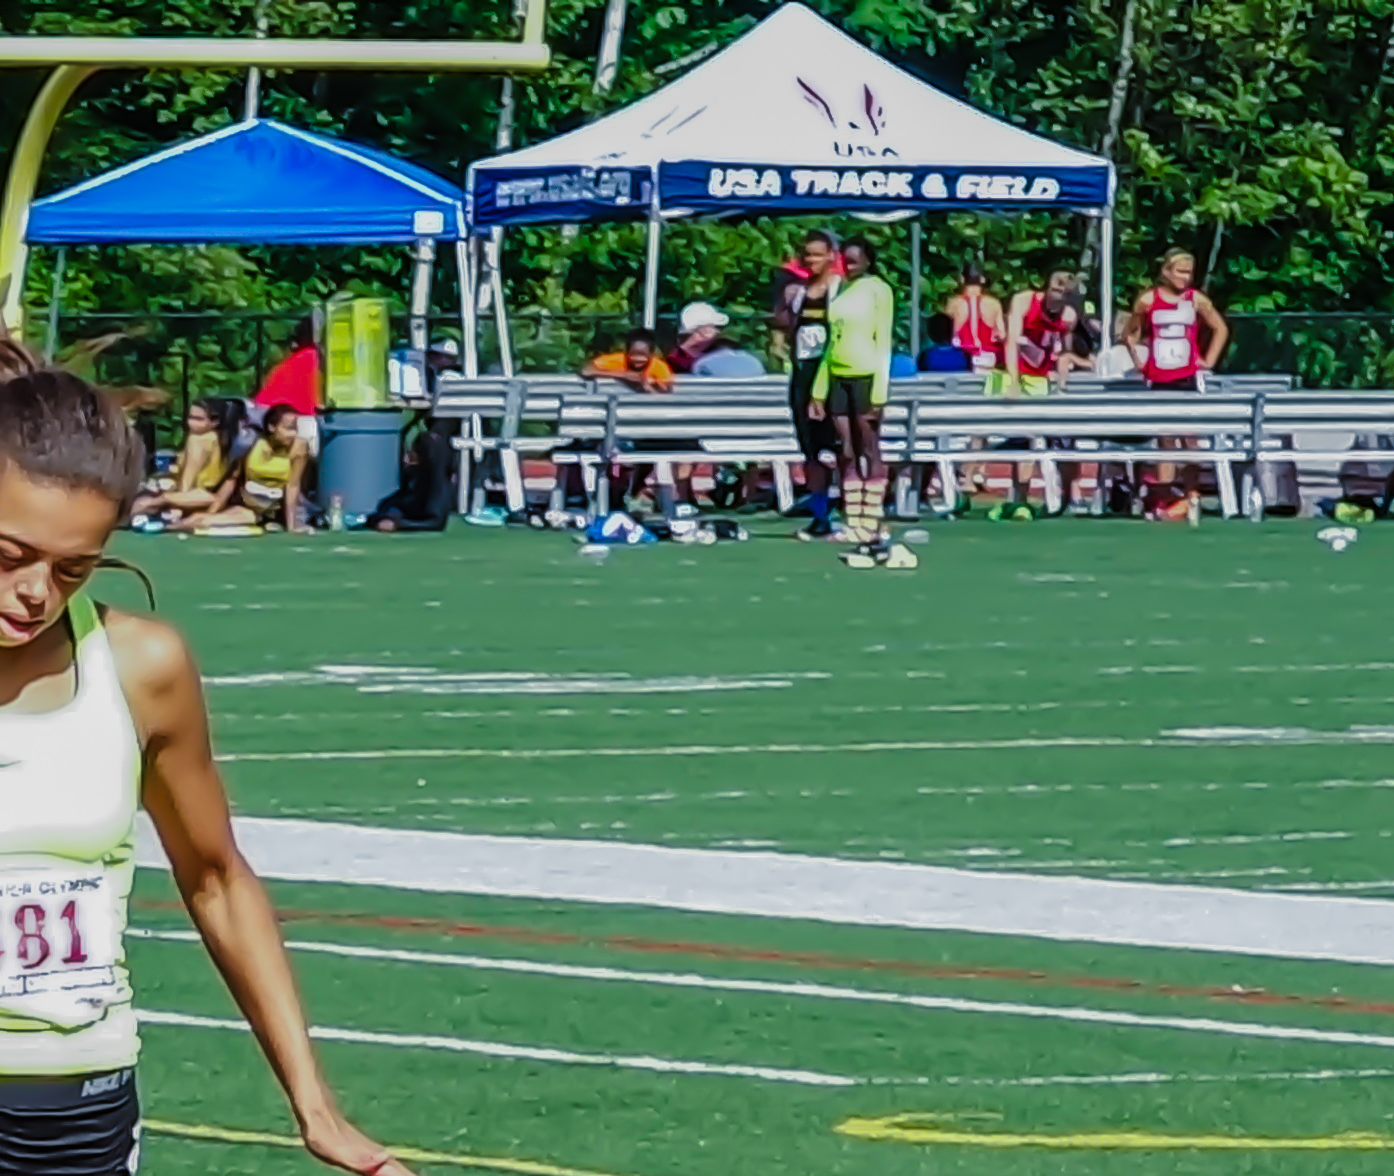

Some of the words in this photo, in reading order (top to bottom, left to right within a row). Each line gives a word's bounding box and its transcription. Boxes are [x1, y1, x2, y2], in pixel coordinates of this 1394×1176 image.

[708, 168, 782, 197] USA
[791, 170, 913, 197] TRACK
[922, 173, 948, 198] &
[956, 175, 1061, 200] FIELD
